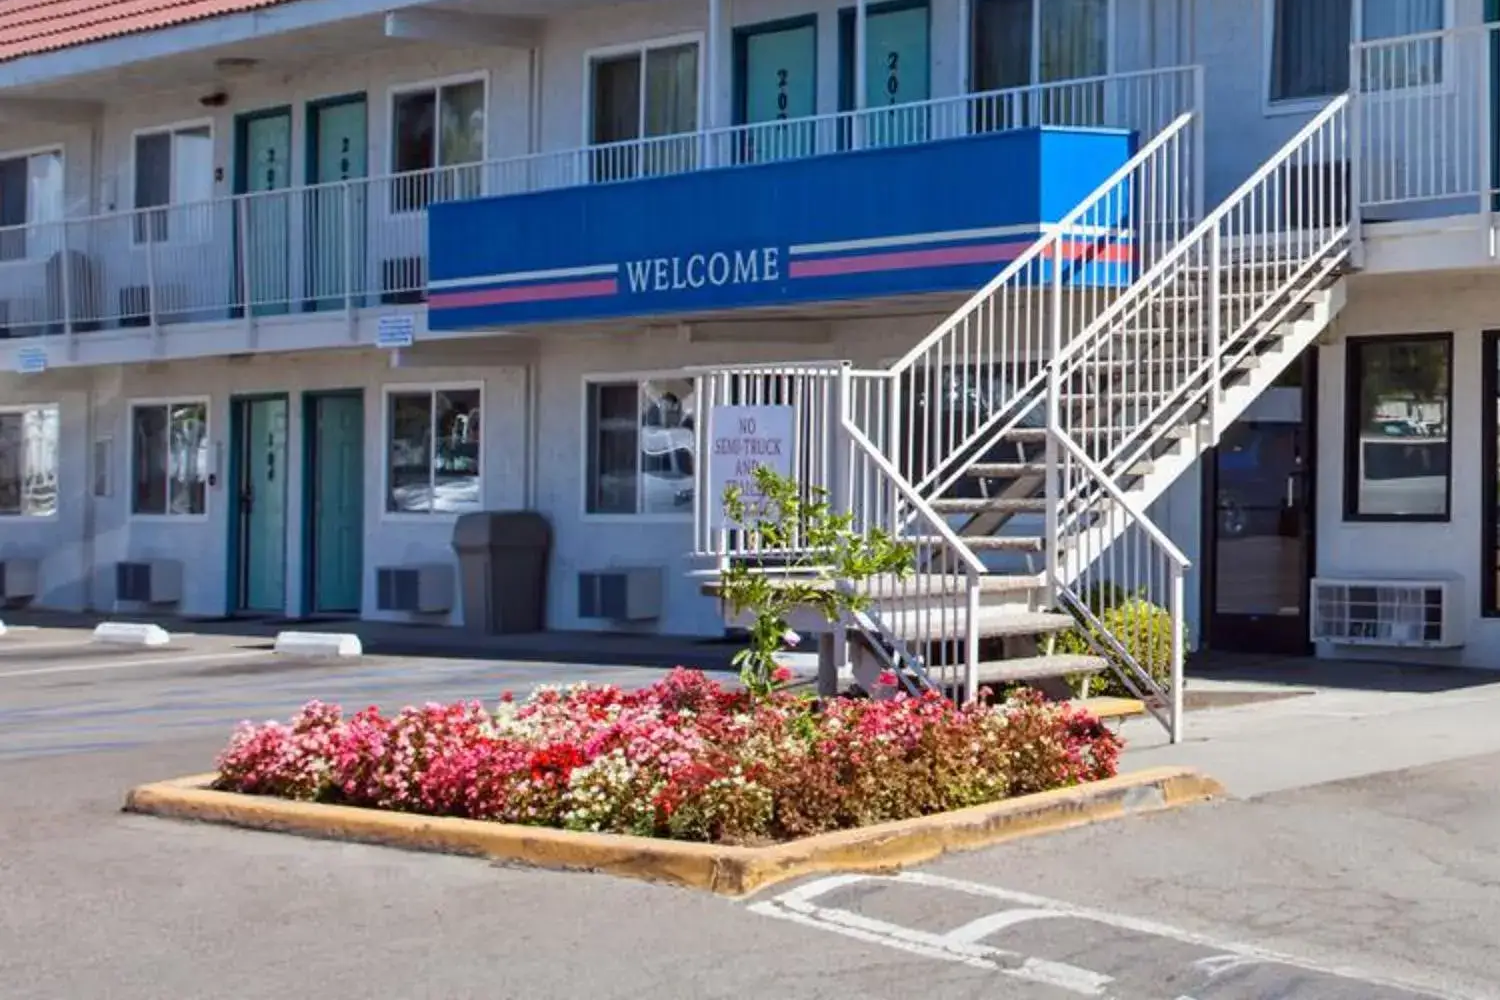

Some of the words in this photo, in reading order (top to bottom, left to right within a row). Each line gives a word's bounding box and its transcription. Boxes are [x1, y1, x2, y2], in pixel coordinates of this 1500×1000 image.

[341, 136, 349, 180] 20
[625, 247, 779, 293] WELCOME
[738, 418, 756, 434] NO
